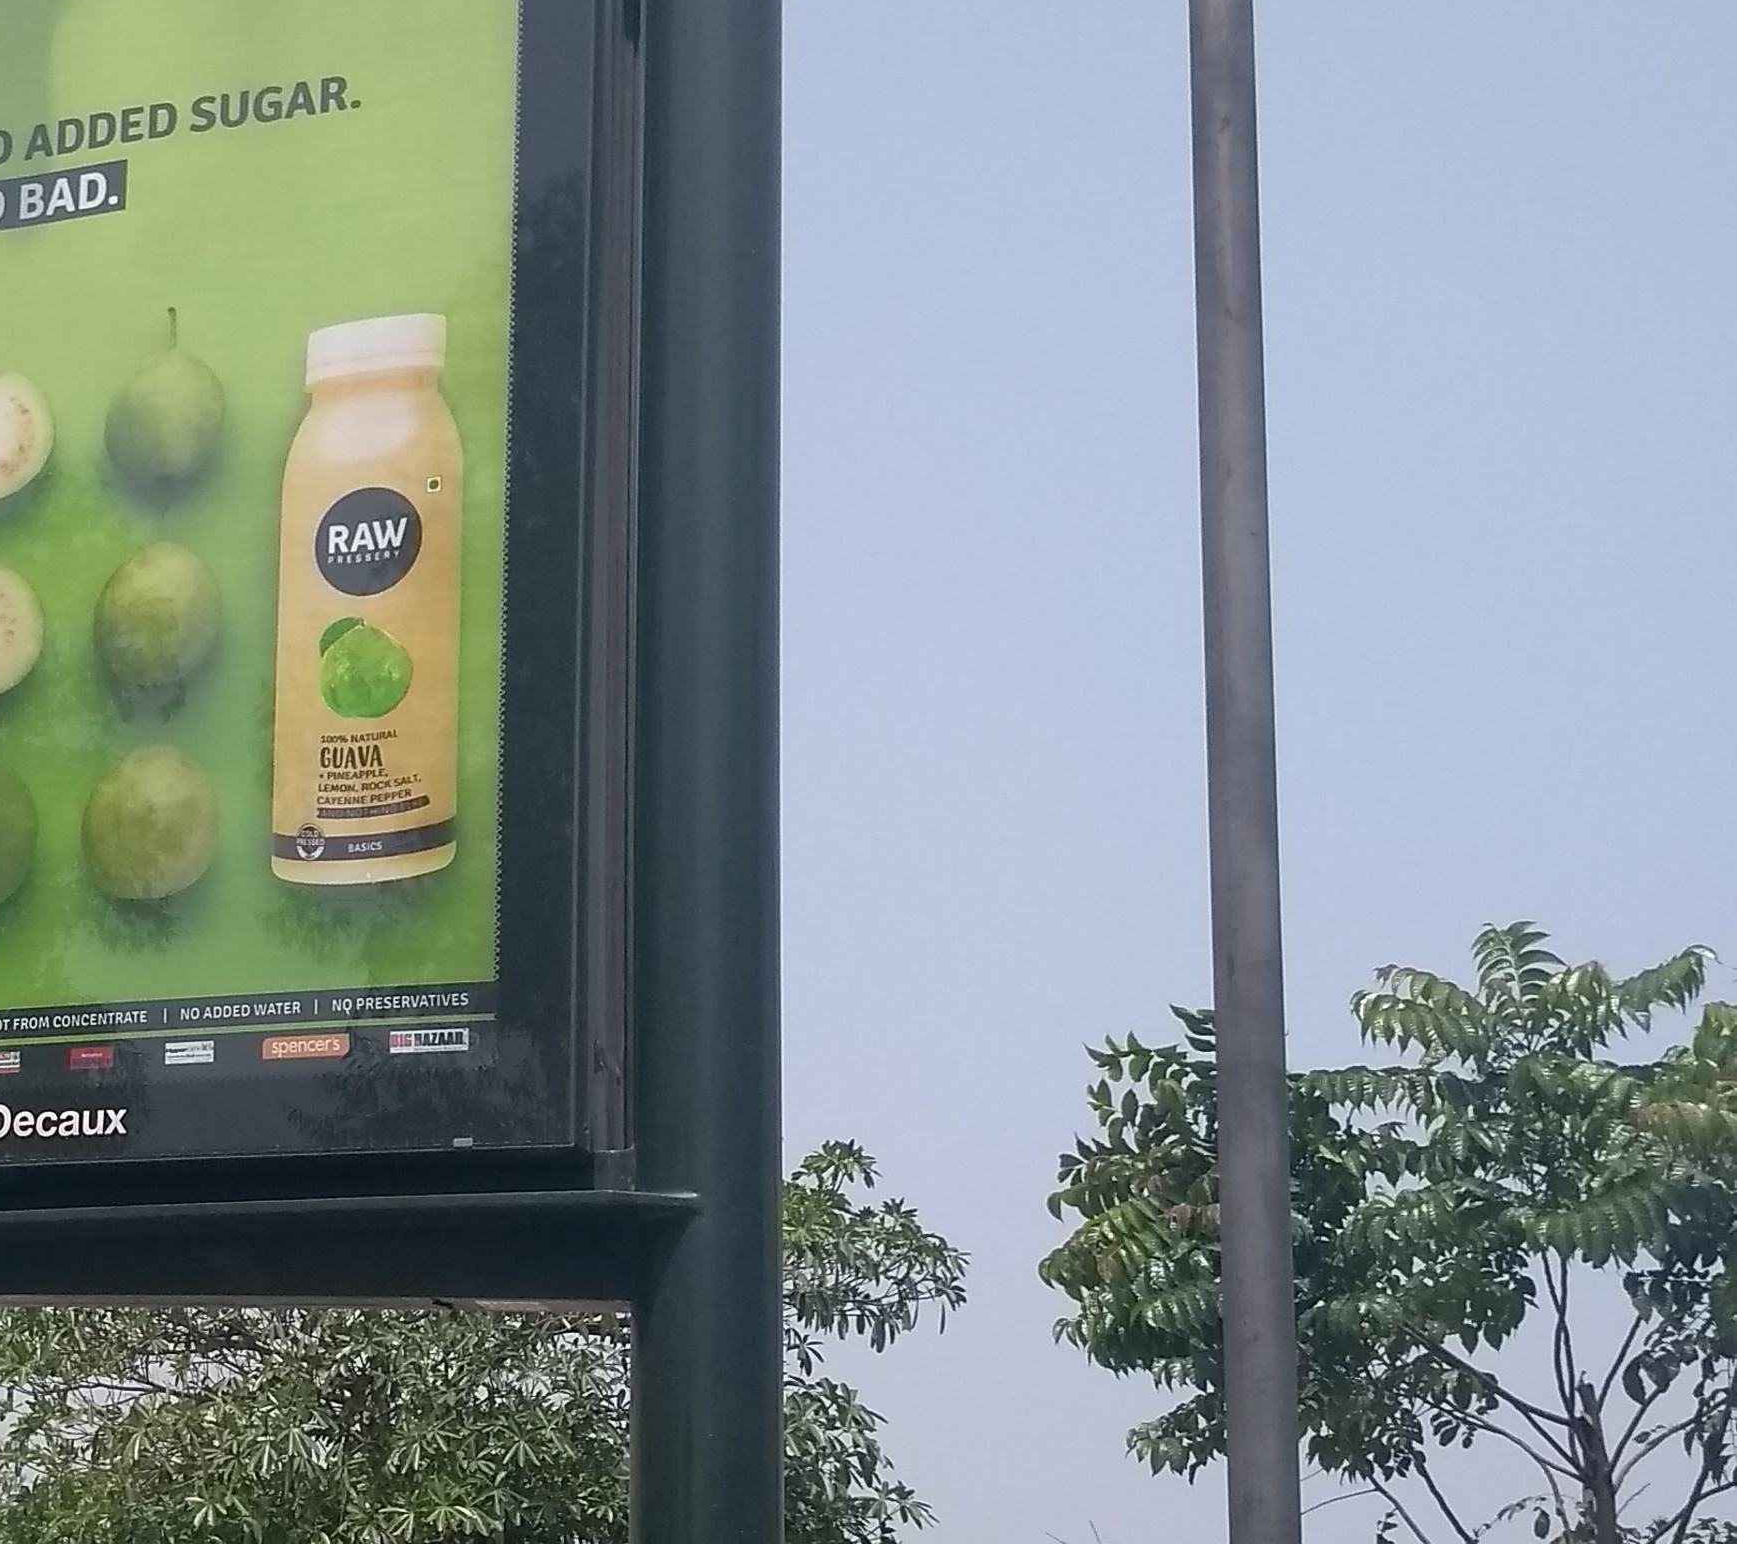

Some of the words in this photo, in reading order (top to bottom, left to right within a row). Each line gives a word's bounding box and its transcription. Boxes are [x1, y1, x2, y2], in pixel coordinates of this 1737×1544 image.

[24, 102, 178, 161] ADDED
[189, 75, 362, 133] SUGAR.
[18, 172, 119, 221] BAD.
[328, 517, 408, 554] RAW
[327, 549, 401, 564] PRESSERY
[321, 734, 349, 744] 100%
[350, 729, 399, 743] NATURAL
[320, 744, 384, 770] GUAVA
[318, 782, 359, 794] LEMON,
[361, 780, 392, 792] ROCK
[393, 773, 423, 787] SALT,
[327, 768, 389, 781] PINEAPPLE,
[316, 795, 368, 805] CAYENNE
[370, 788, 413, 804] PEPPER
[347, 841, 383, 852] BASICS
[180, 1007, 201, 1020] NO
[203, 1004, 251, 1019] ADDED
[254, 1001, 301, 1016] WATER
[356, 992, 470, 1011] PRESERVATIVES
[13, 1016, 51, 1030] FROM
[52, 1010, 148, 1028] CONCENTRATE
[271, 1037, 342, 1058] spencer's
[390, 1033, 413, 1048] BIG
